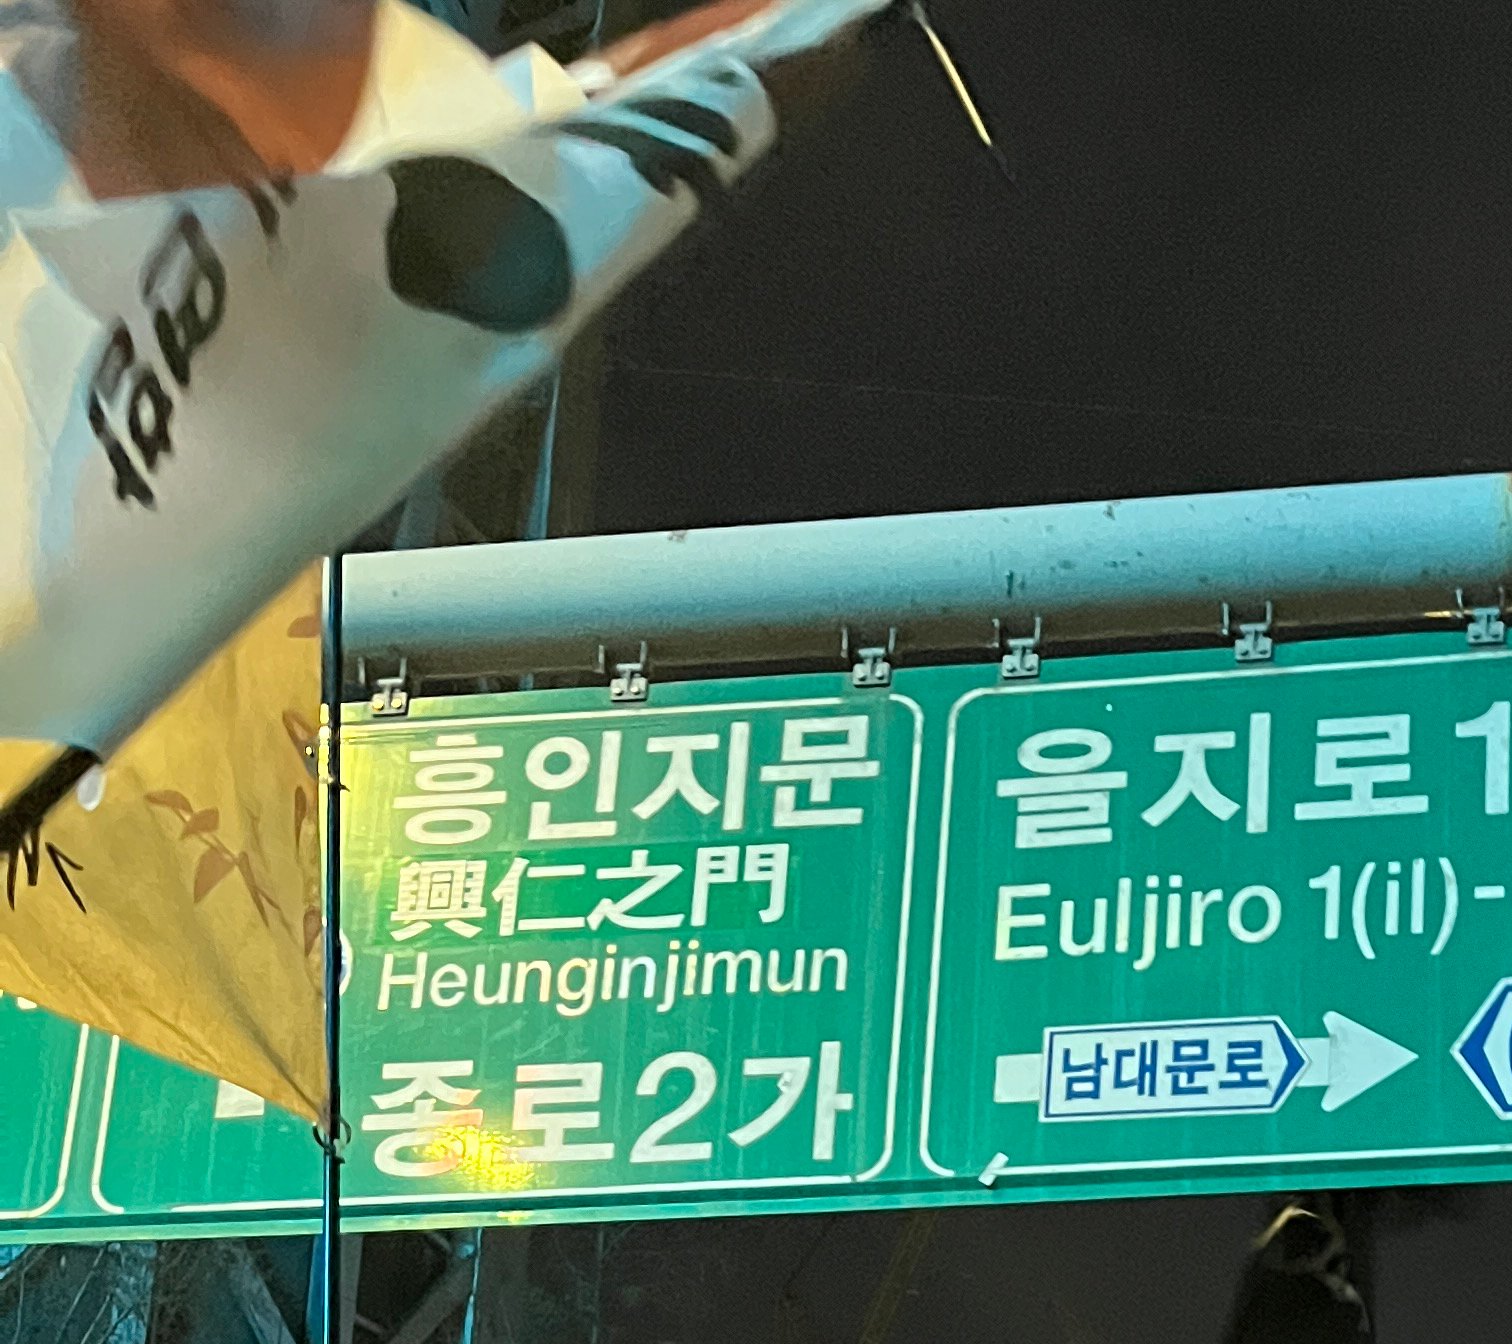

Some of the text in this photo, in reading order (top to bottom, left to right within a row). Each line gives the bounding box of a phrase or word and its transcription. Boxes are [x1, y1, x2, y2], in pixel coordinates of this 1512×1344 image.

[392, 714, 882, 846] 흥인지문
[389, 842, 791, 942] 興仁之門
[993, 874, 1283, 971] Euljiro
[377, 945, 849, 1017] Heunginjimun
[361, 1040, 855, 1178] 종로2가
[1060, 1035, 1275, 1102] 남대문로
